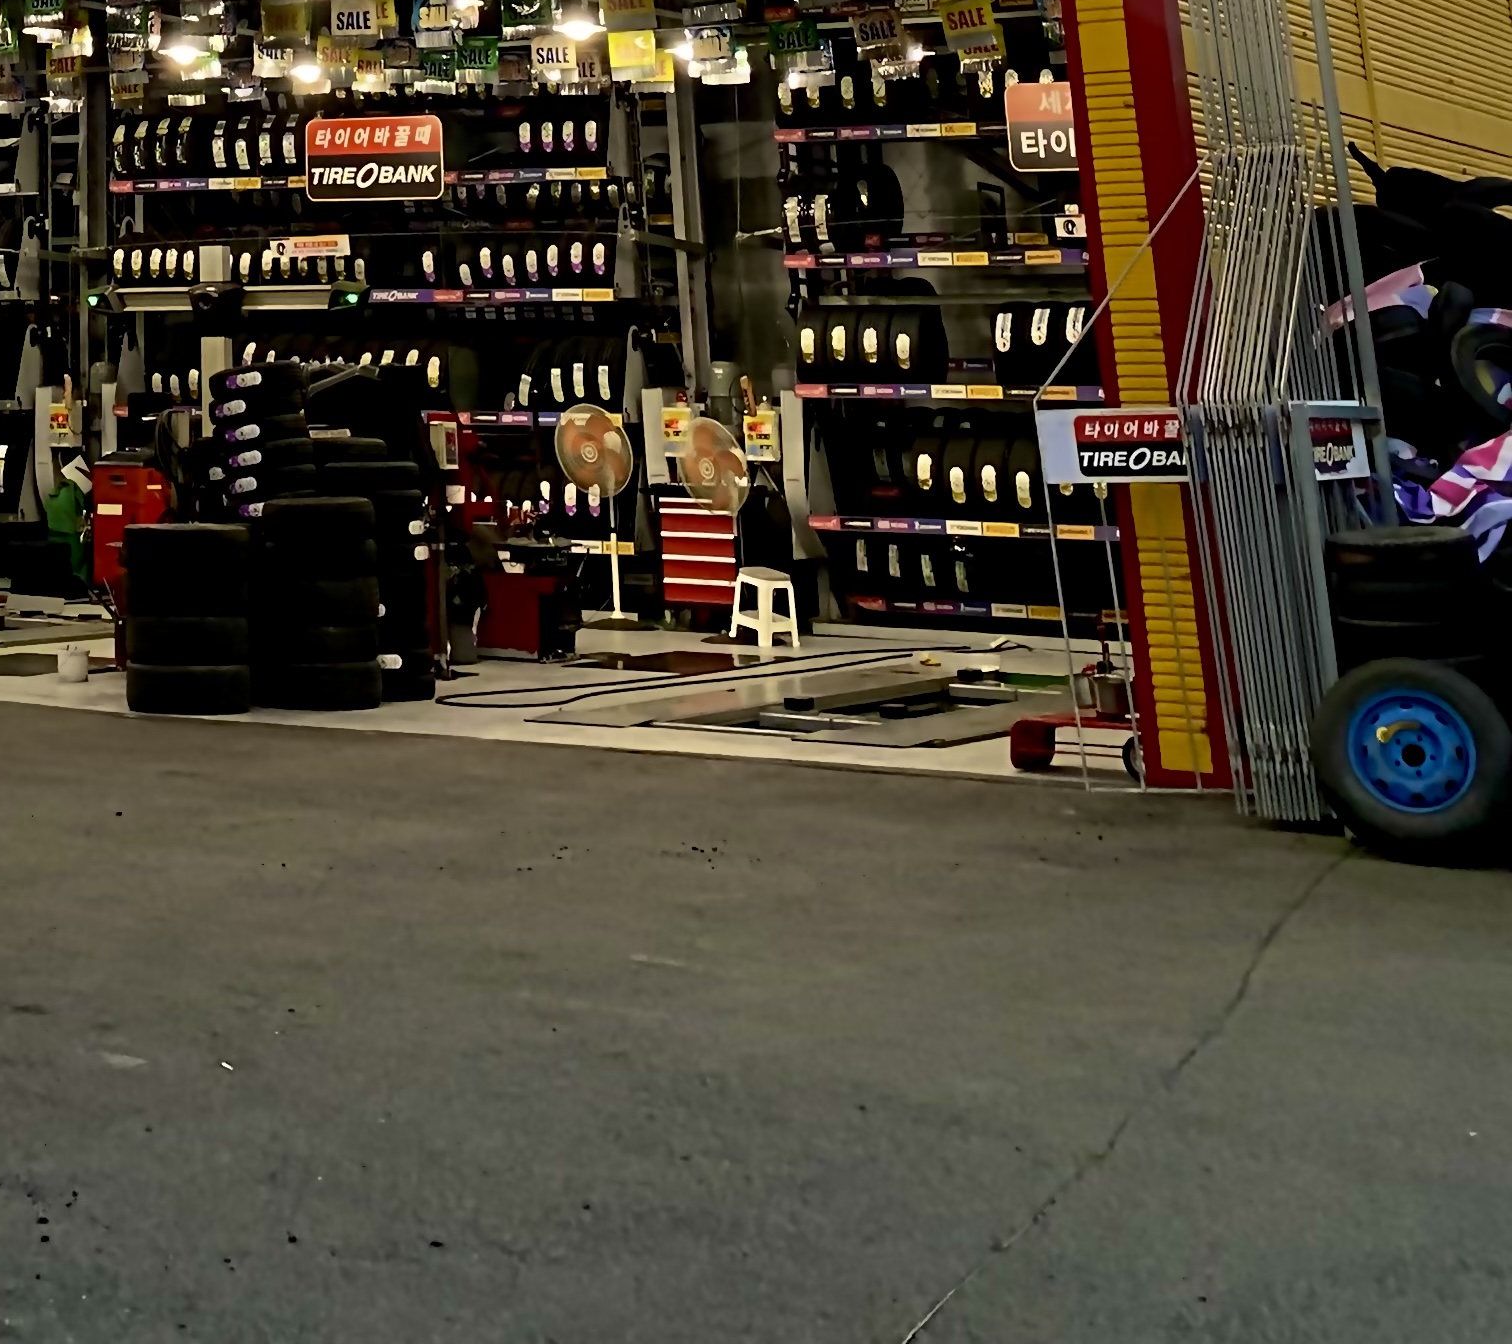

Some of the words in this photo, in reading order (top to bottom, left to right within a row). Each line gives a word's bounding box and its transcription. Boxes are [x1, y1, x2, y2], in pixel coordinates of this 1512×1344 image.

[337, 10, 372, 31] SALE
[947, 8, 987, 31] SALE
[859, 20, 898, 42] SALE
[778, 32, 814, 50] SALE
[322, 46, 352, 64] SALE
[461, 47, 492, 67] SALE
[536, 46, 570, 64] SALE
[49, 56, 77, 75] SALE
